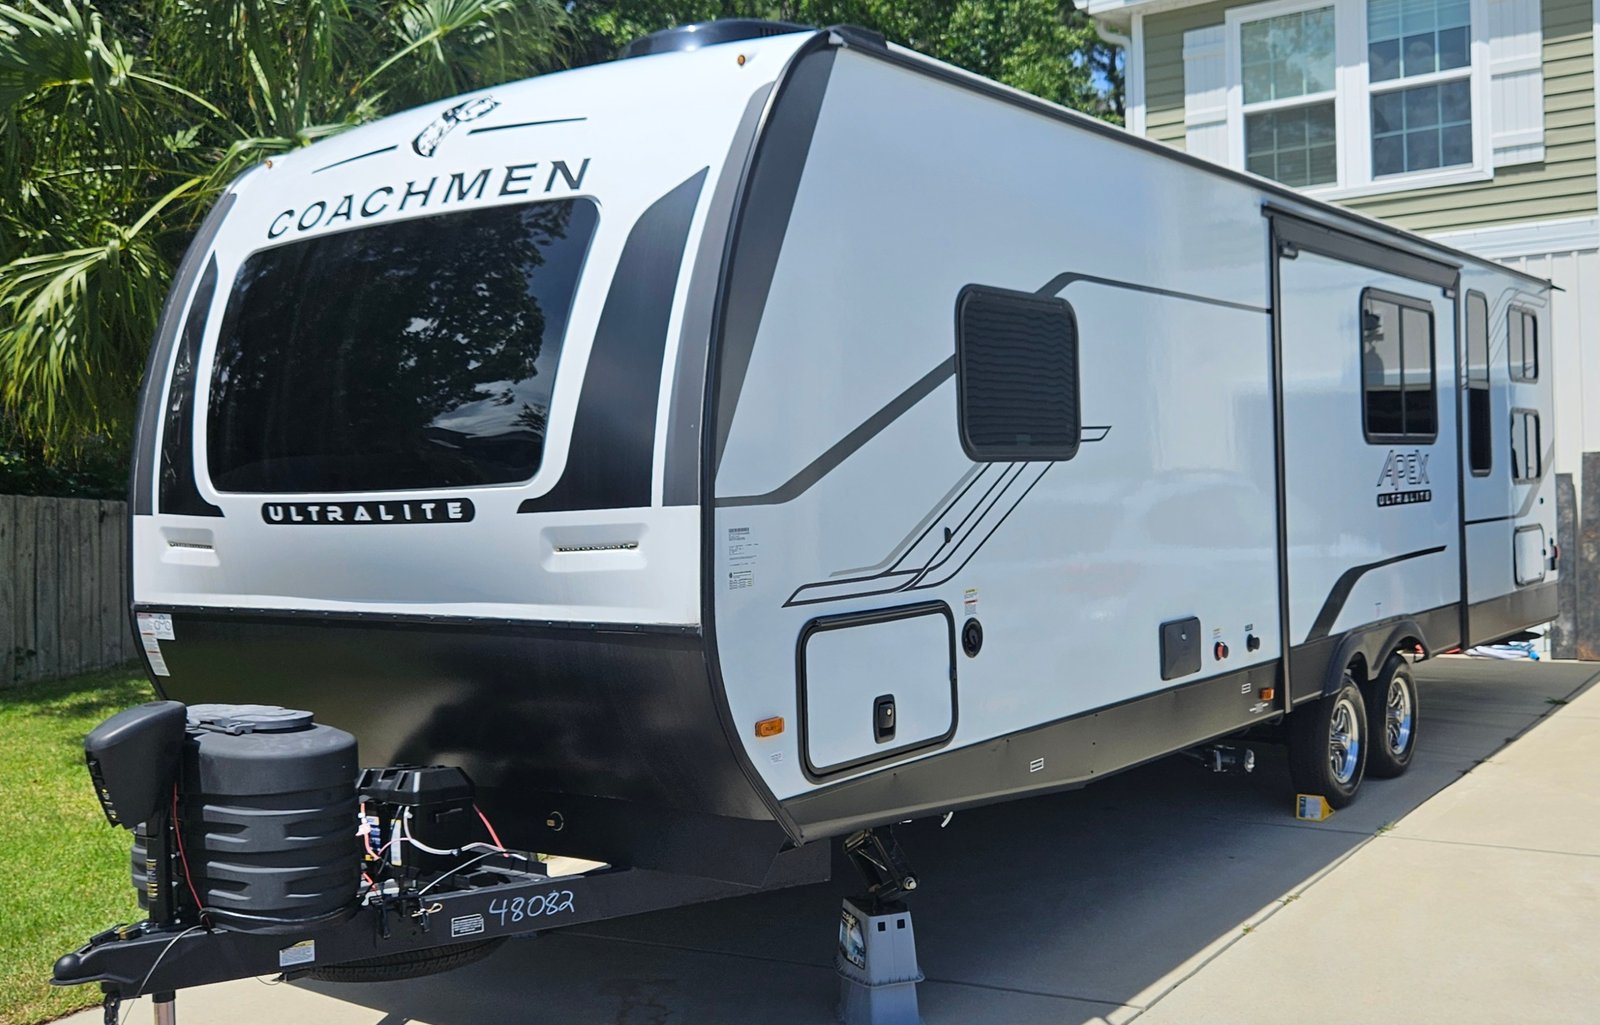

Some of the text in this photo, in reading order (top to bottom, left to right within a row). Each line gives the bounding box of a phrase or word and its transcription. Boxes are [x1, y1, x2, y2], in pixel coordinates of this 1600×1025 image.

[267, 158, 591, 239] COACHMEN
[1376, 449, 1430, 491] APEX
[268, 502, 463, 522] ULTRALITE
[1378, 491, 1430, 505] ULTRALITE
[488, 890, 575, 926] 48082
